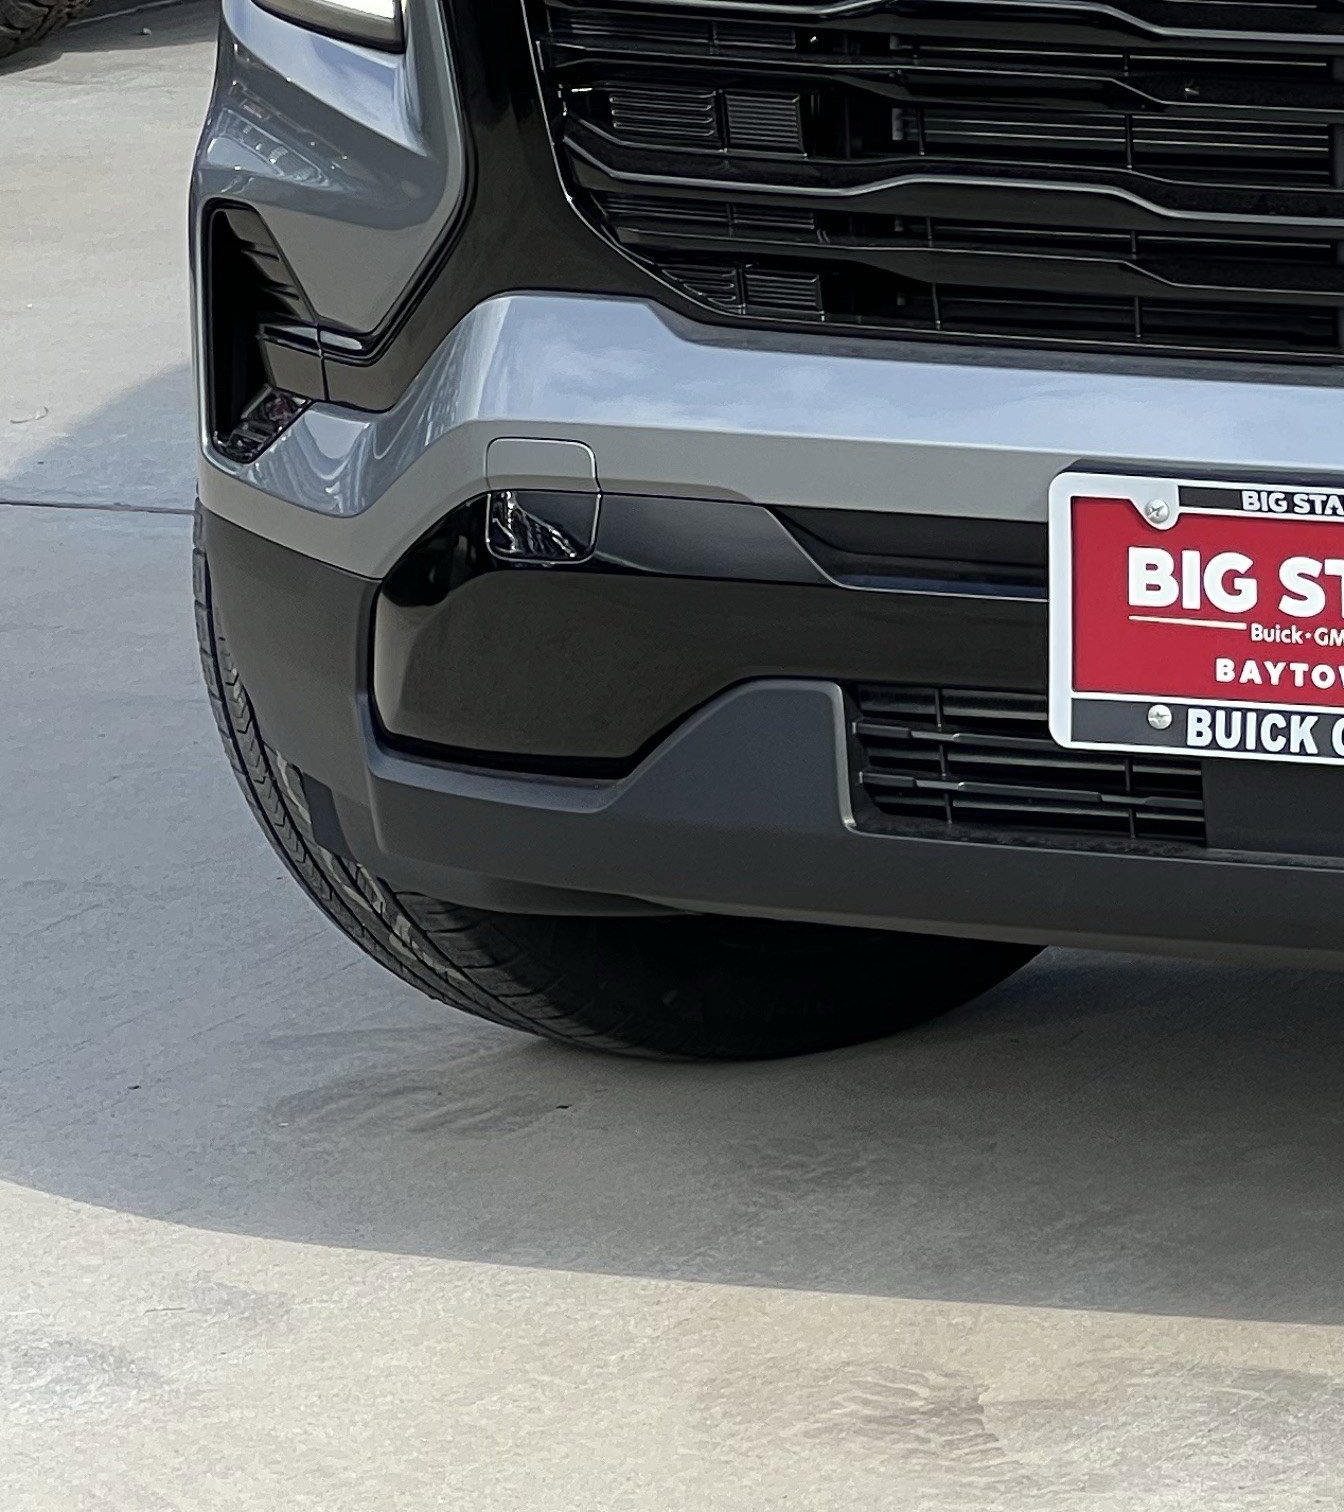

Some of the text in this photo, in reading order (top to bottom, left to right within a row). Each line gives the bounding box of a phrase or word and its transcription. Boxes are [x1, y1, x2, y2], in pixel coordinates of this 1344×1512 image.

[1241, 490, 1288, 513] BIG
[1127, 546, 1259, 614] BIG
[1250, 622, 1303, 645] Buick
[1185, 707, 1319, 755] BUICK
